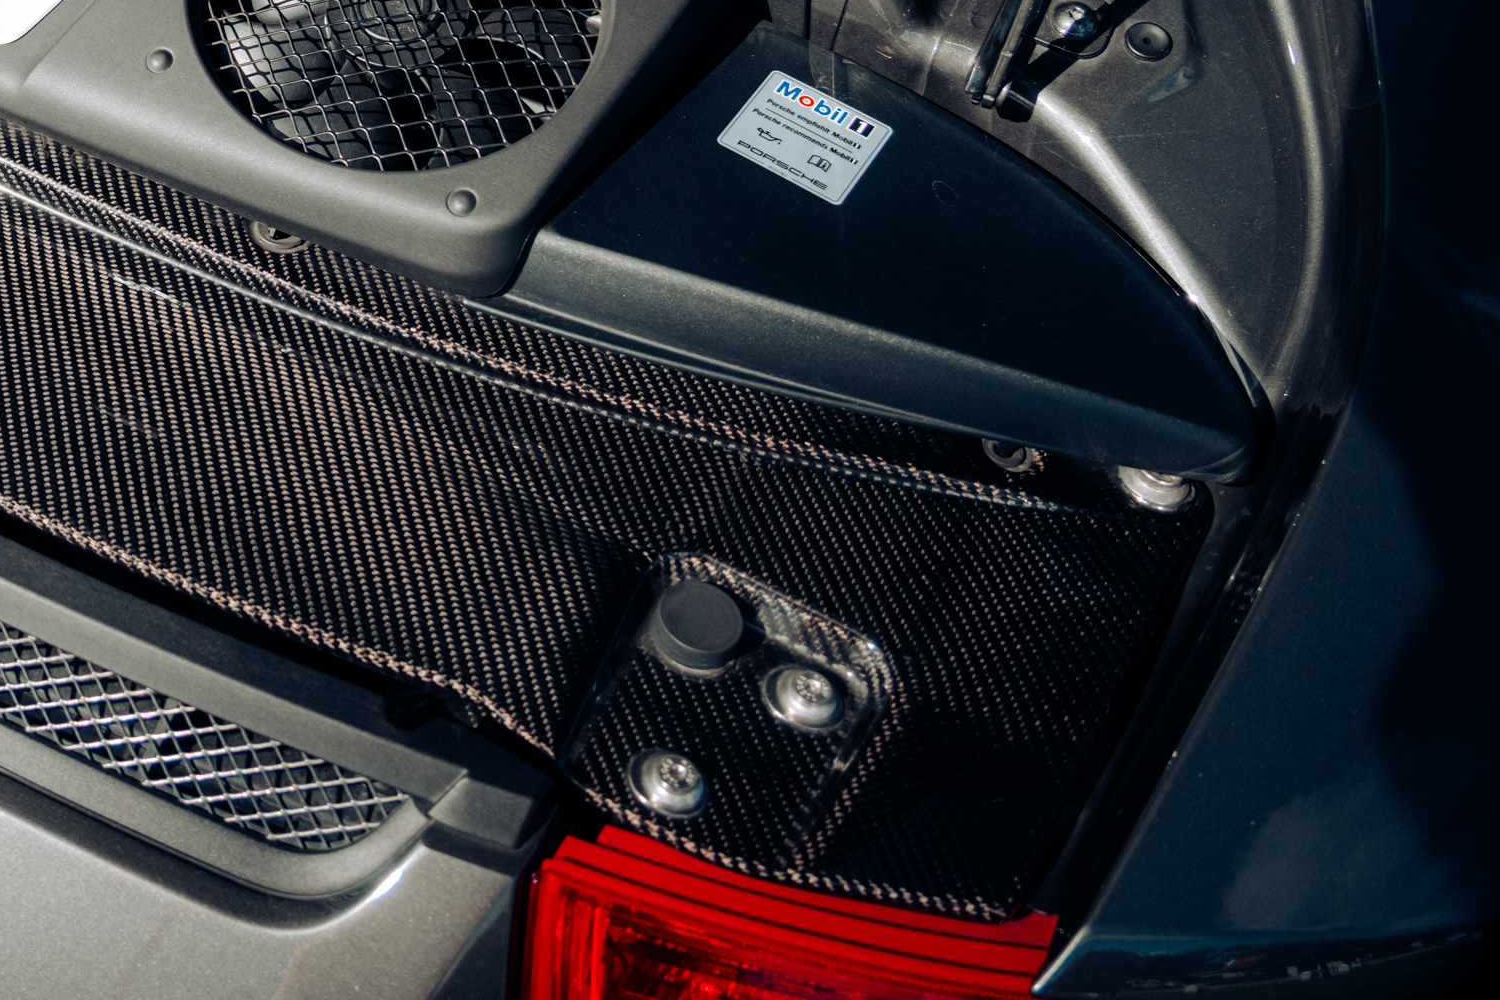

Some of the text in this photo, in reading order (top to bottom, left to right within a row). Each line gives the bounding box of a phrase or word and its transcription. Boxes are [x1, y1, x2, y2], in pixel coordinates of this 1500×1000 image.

[766, 98, 796, 116] Porsche
[796, 114, 831, 134] empfiehlt
[775, 80, 849, 125] Mobil
[752, 107, 782, 126] Porsche
[781, 123, 829, 150] recommends
[737, 140, 828, 190] PORSCHE
